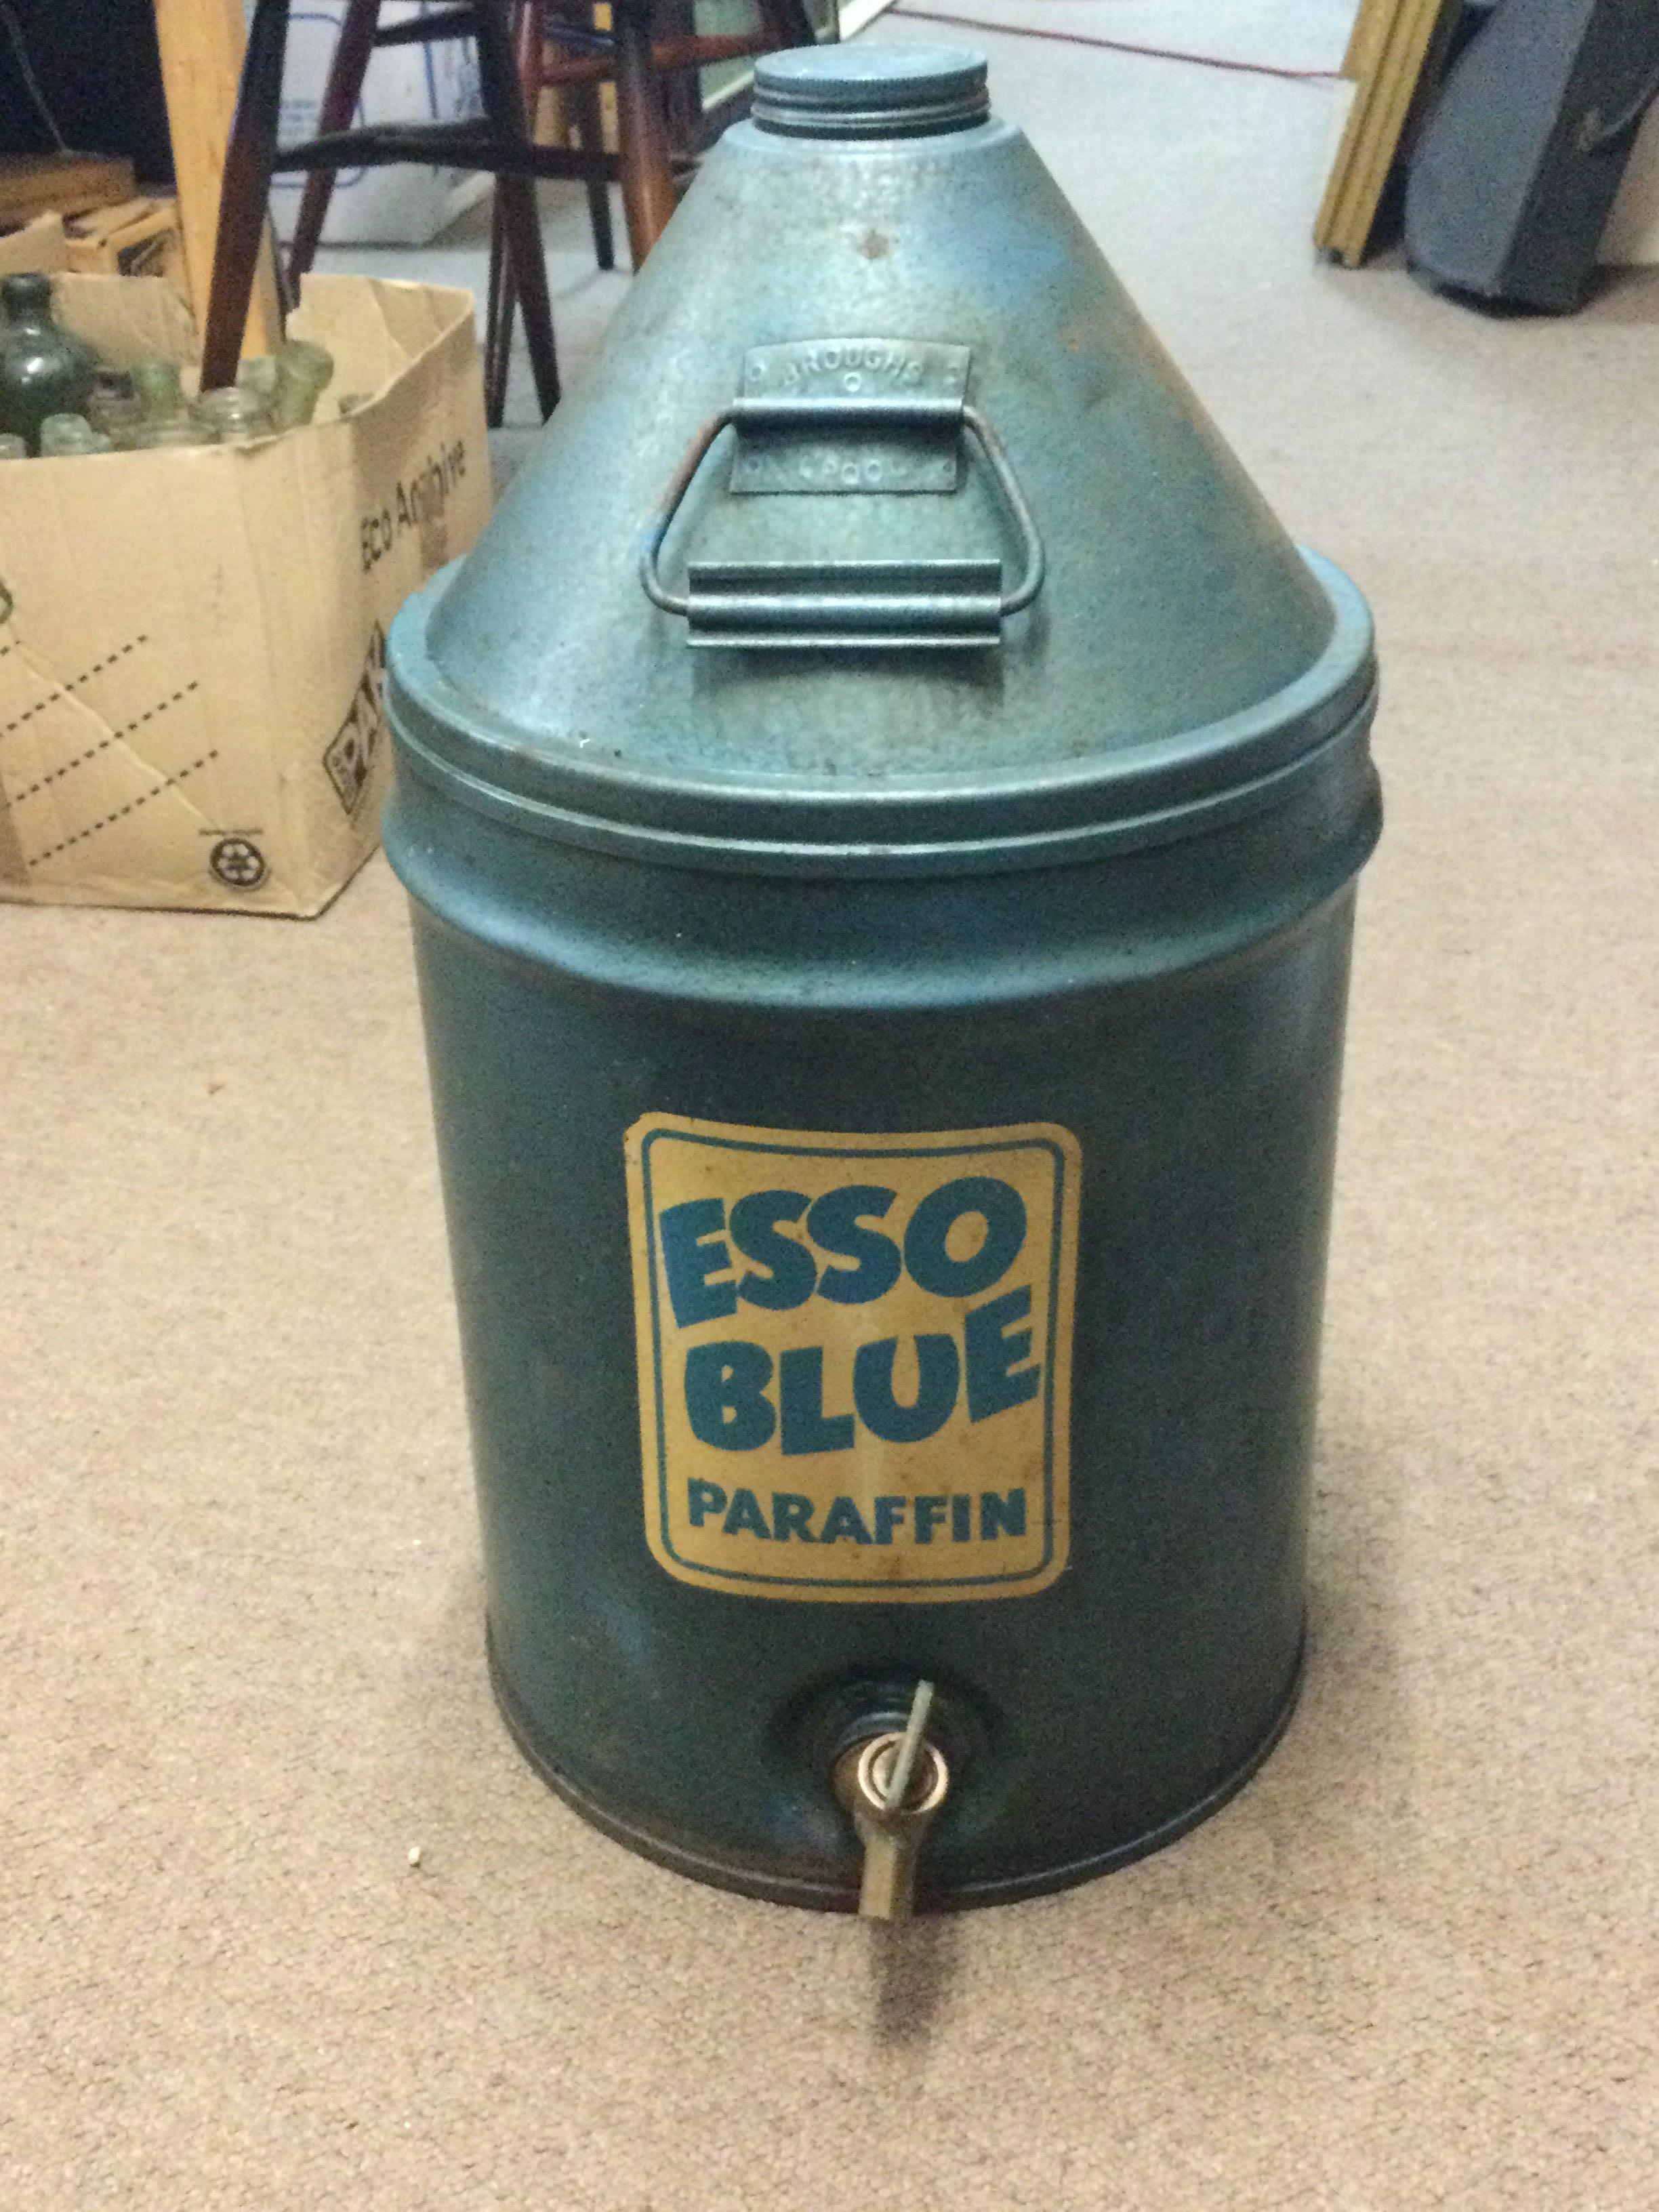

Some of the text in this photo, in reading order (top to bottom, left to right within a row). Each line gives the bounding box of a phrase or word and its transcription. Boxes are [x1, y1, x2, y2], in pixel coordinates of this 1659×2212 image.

[659, 1176, 1027, 1329] ESSO
[684, 1285, 1041, 1456] BLUE
[687, 1477, 1027, 1545] PARAFFIN
